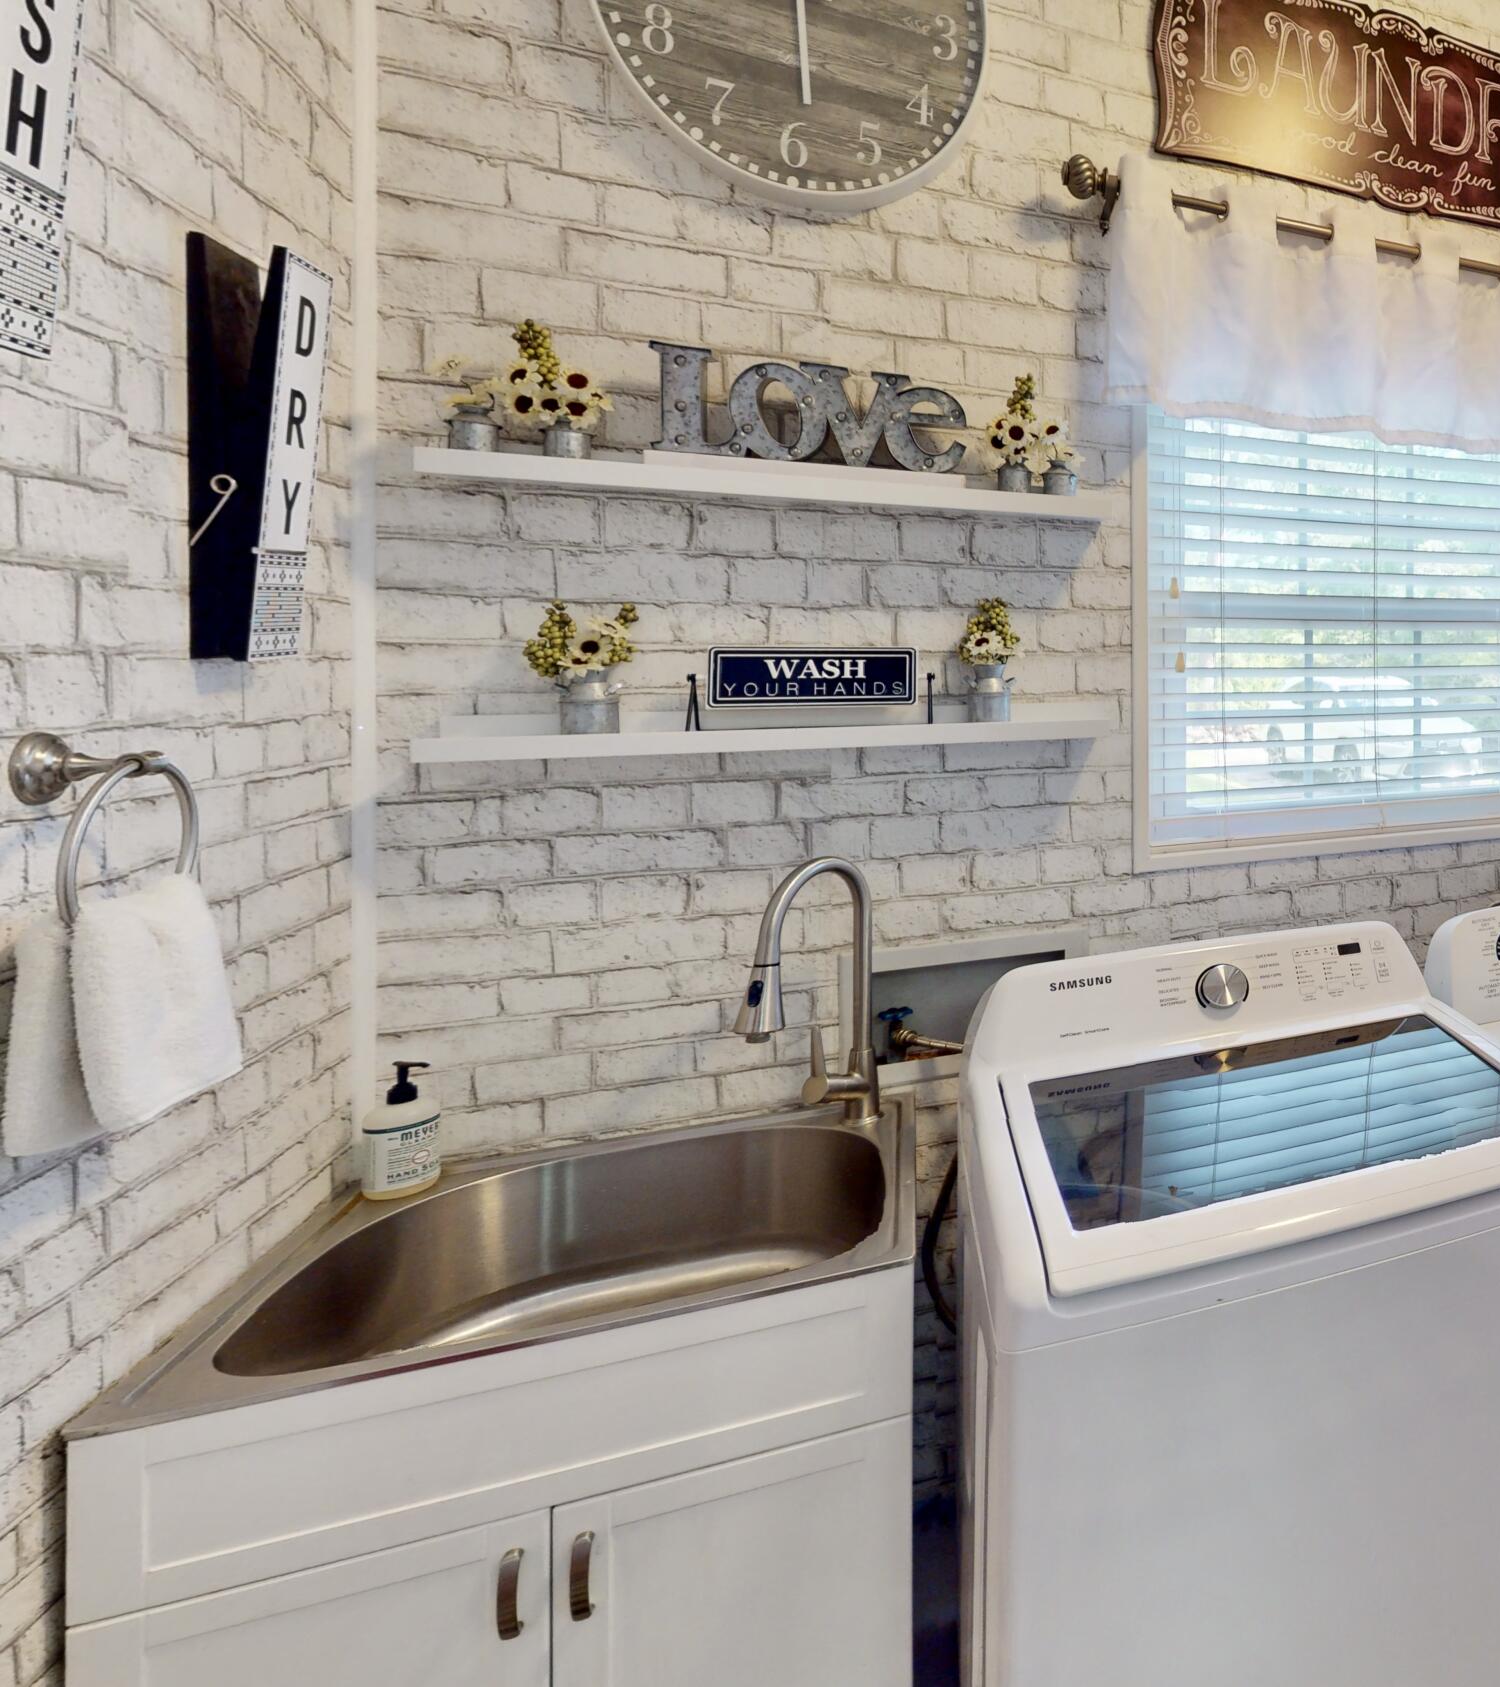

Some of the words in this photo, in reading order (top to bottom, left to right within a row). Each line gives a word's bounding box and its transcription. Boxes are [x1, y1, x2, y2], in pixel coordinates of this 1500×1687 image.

[642, 3, 673, 54] 8
[933, 15, 958, 61] 3
[705, 77, 735, 126] 7
[906, 84, 934, 127] 4
[780, 122, 808, 168] 6
[857, 121, 882, 166] 5
[1298, 131, 1358, 156] ood
[1369, 144, 1442, 177] clean
[1450, 161, 1496, 196] fun
[282, 295, 316, 535] DRY
[724, 683, 800, 696] YOUR
[814, 682, 905, 696] HANDS
[764, 659, 866, 679] WASH
[1050, 975, 1112, 992] SAMSUNG
[387, 1169, 418, 1179] HAND
